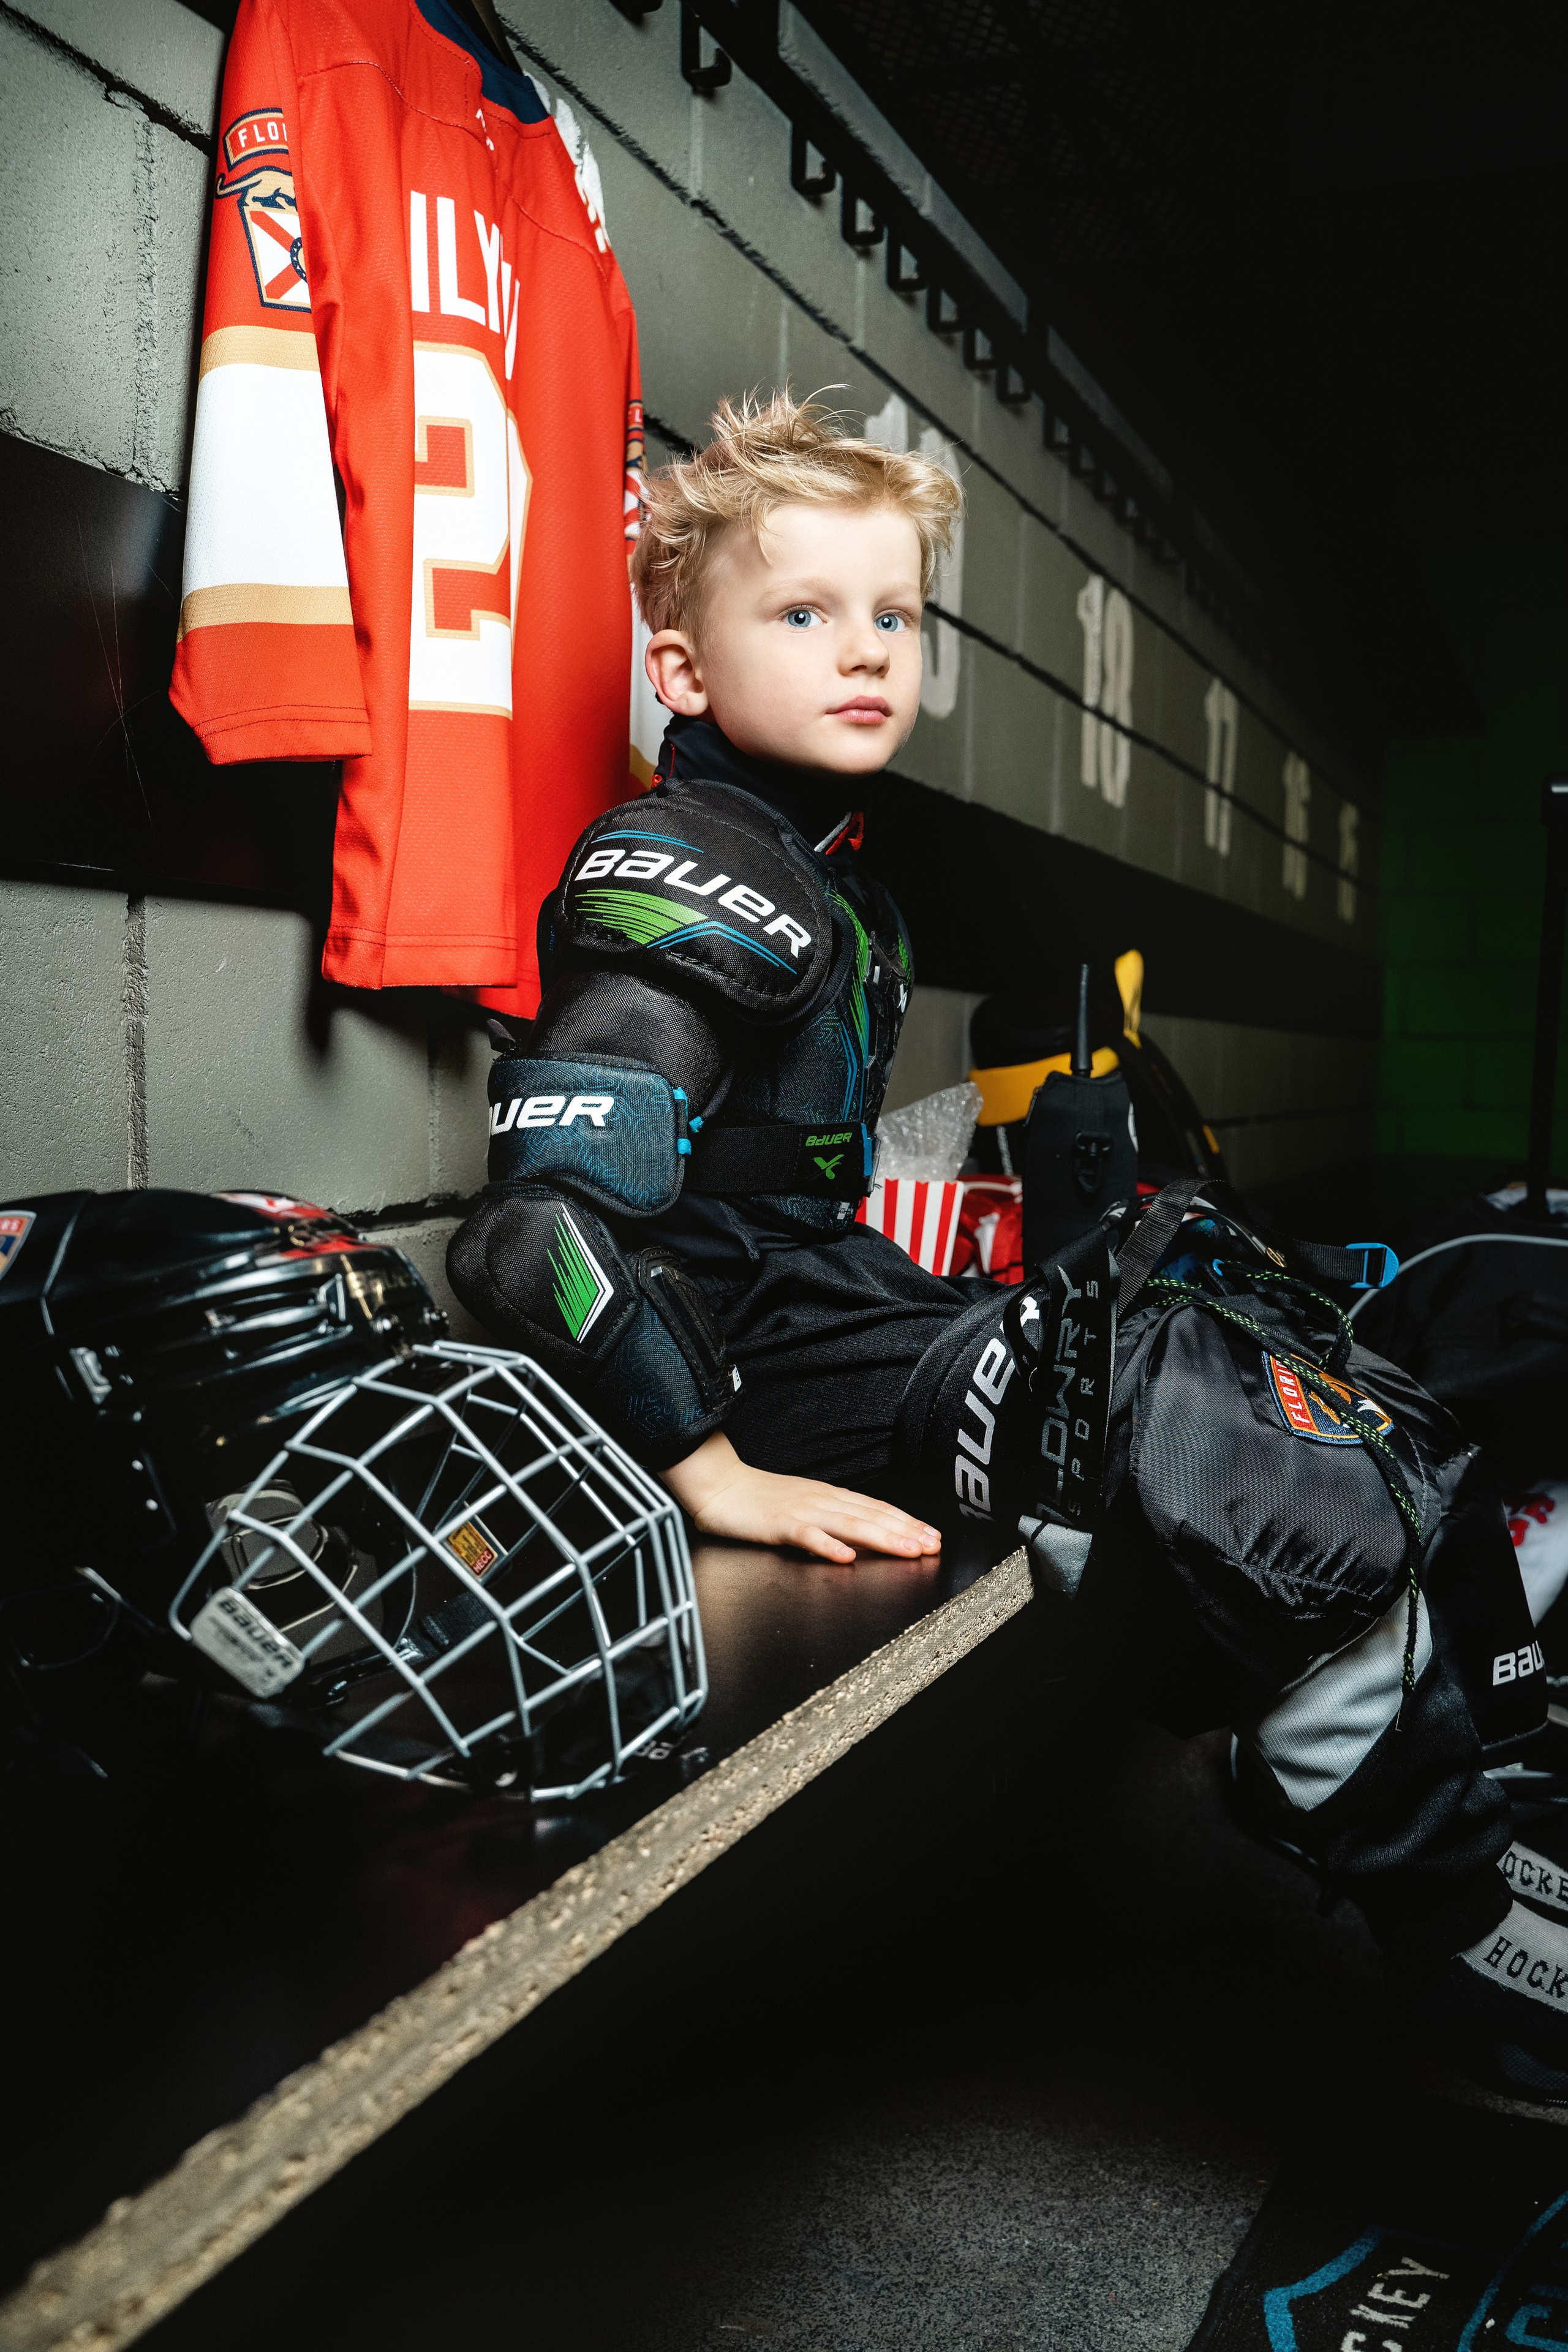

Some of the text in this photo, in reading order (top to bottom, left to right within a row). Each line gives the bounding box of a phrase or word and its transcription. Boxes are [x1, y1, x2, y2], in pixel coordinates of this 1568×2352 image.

[575, 849, 812, 958] BAUER
[489, 1095, 615, 1136] UER
[805, 1132, 853, 1147] BAUER
[1068, 1280, 1099, 1517] SPORTS
[219, 1597, 292, 1668] BAUER
[1483, 1936, 1568, 1999] HOCK
